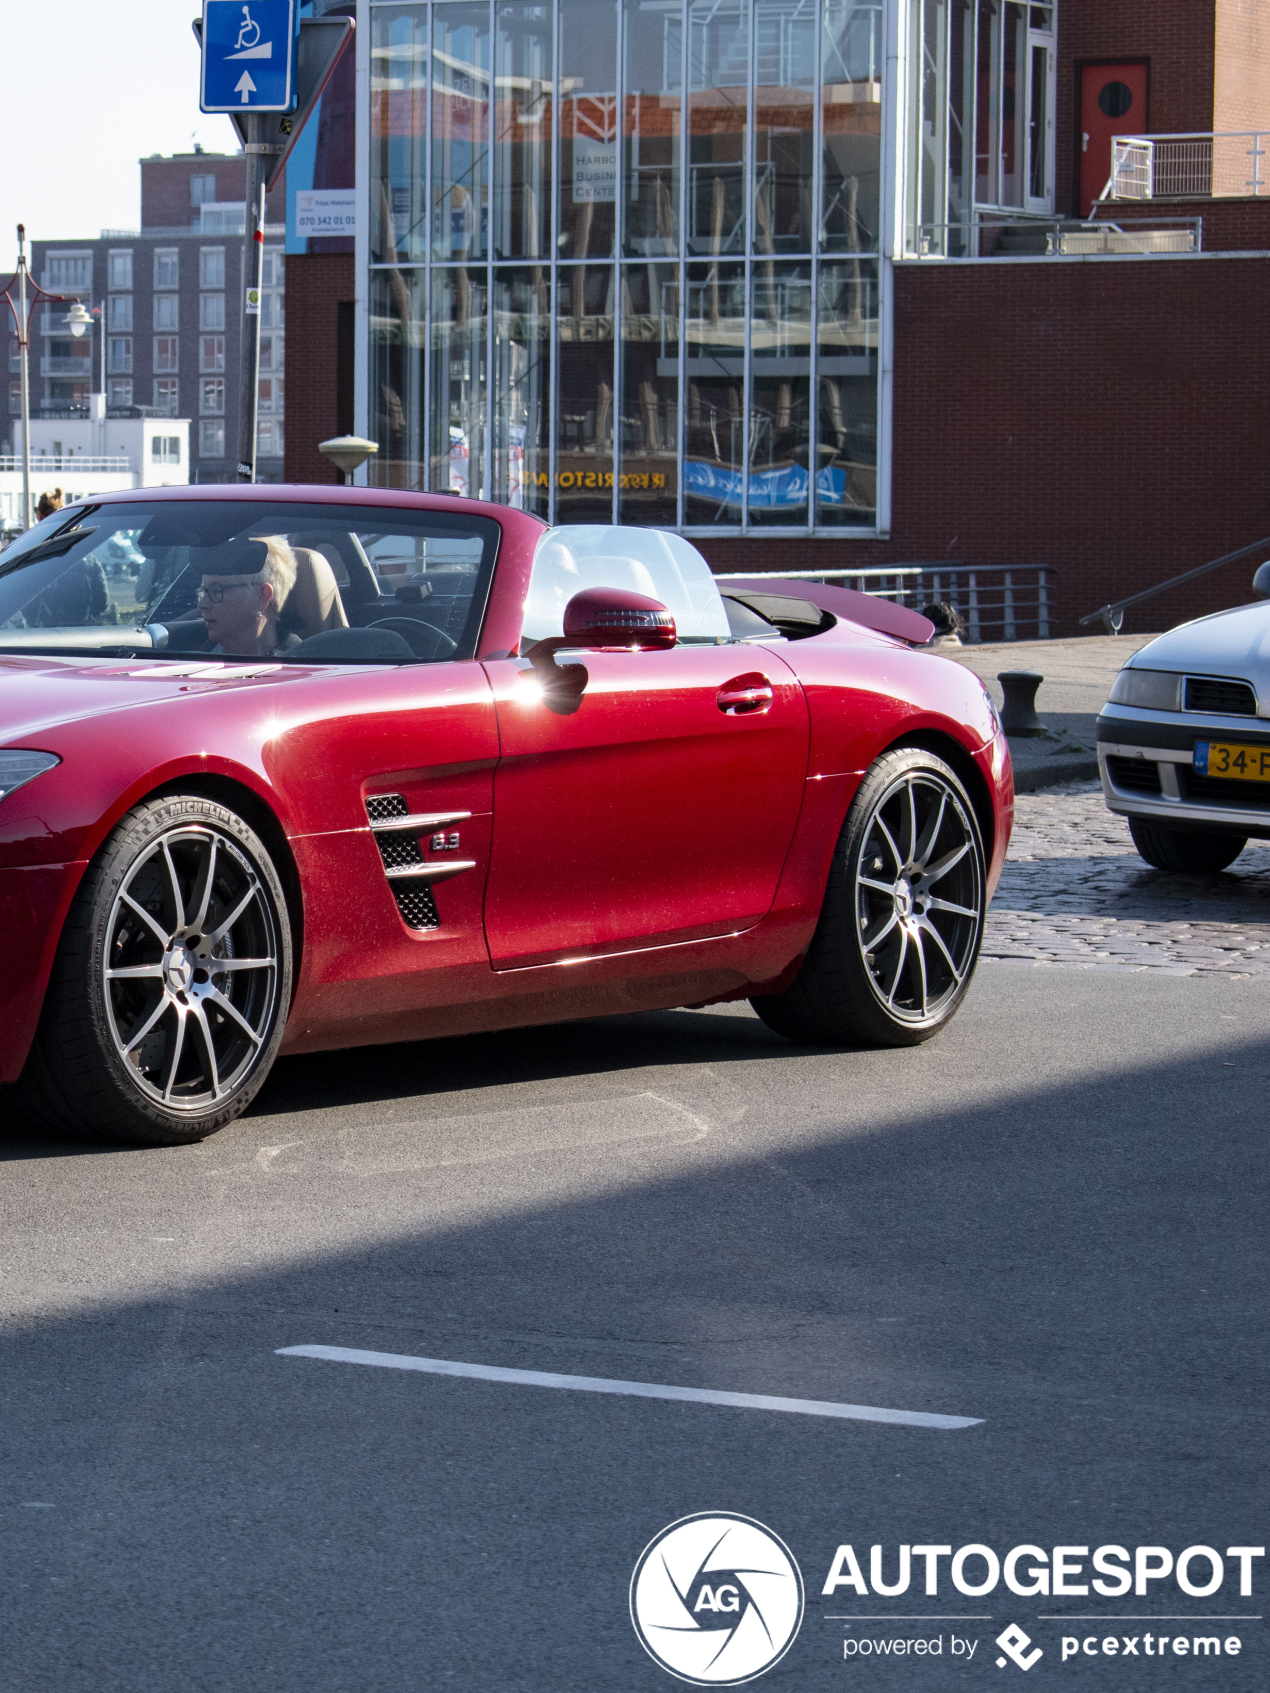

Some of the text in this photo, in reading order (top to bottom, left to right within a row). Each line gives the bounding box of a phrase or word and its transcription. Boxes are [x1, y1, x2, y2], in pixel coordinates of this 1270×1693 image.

[575, 187, 616, 197] CENTE
[299, 217, 315, 226] 070
[317, 216, 332, 225] 342
[333, 216, 343, 225] 01
[170, 801, 231, 823] MICHELIN
[432, 832, 460, 850] 6.3
